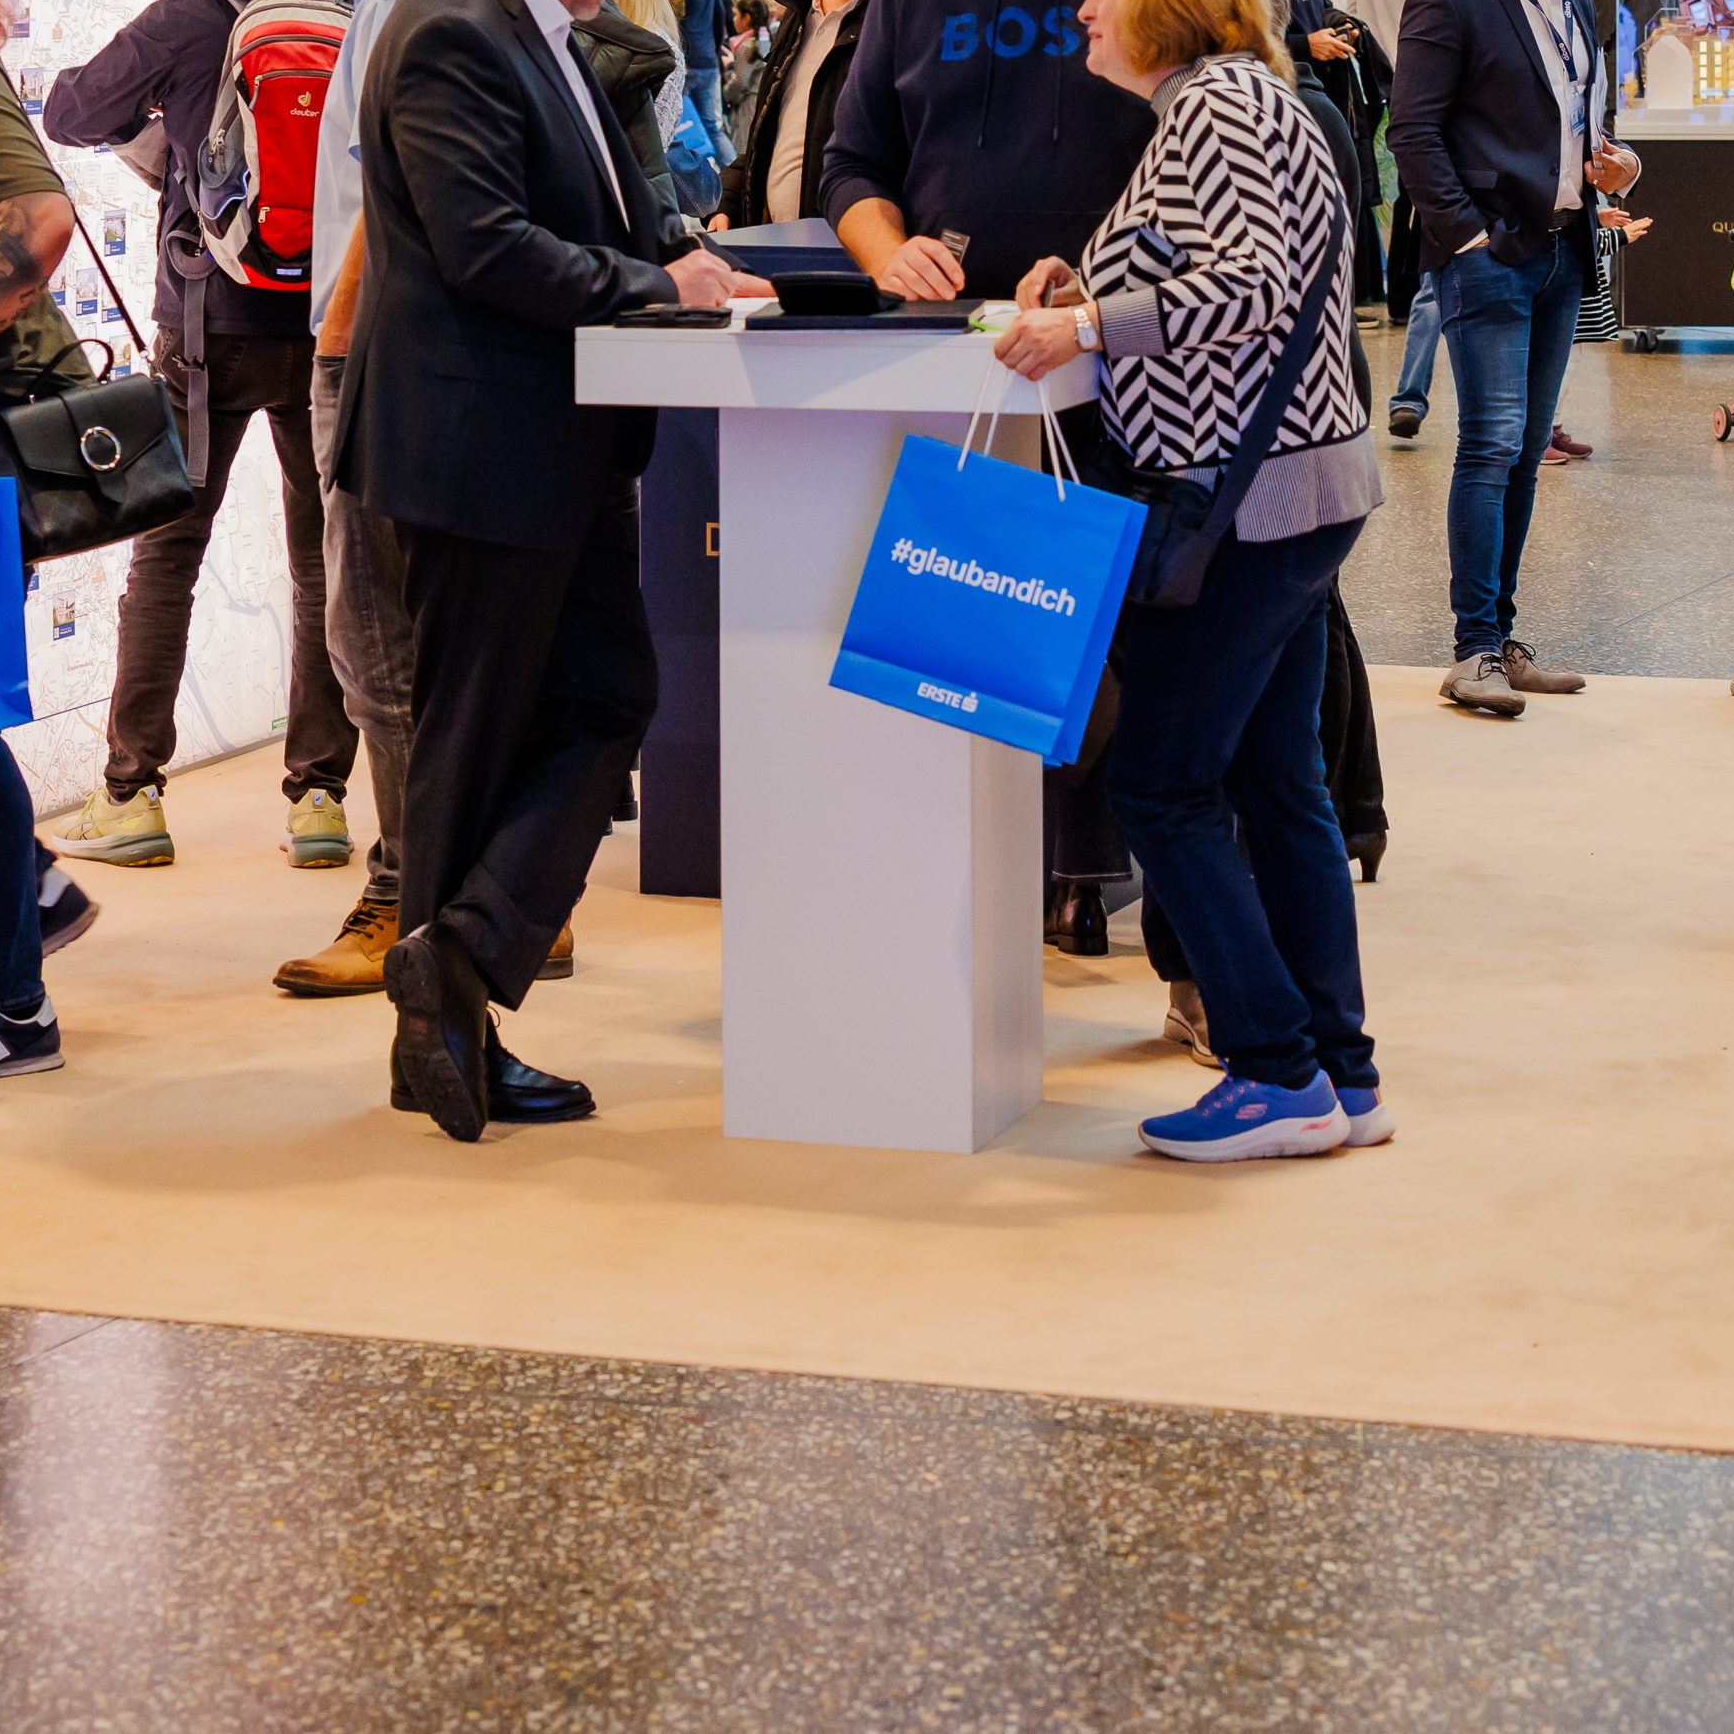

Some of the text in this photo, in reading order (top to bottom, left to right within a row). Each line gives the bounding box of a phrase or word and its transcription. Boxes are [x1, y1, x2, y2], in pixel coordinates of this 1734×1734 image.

[940, 6, 1080, 63] BOS
[290, 107, 320, 117] deuter
[890, 537, 1076, 617] #glaubandich
[917, 681, 962, 710] ERSTE
